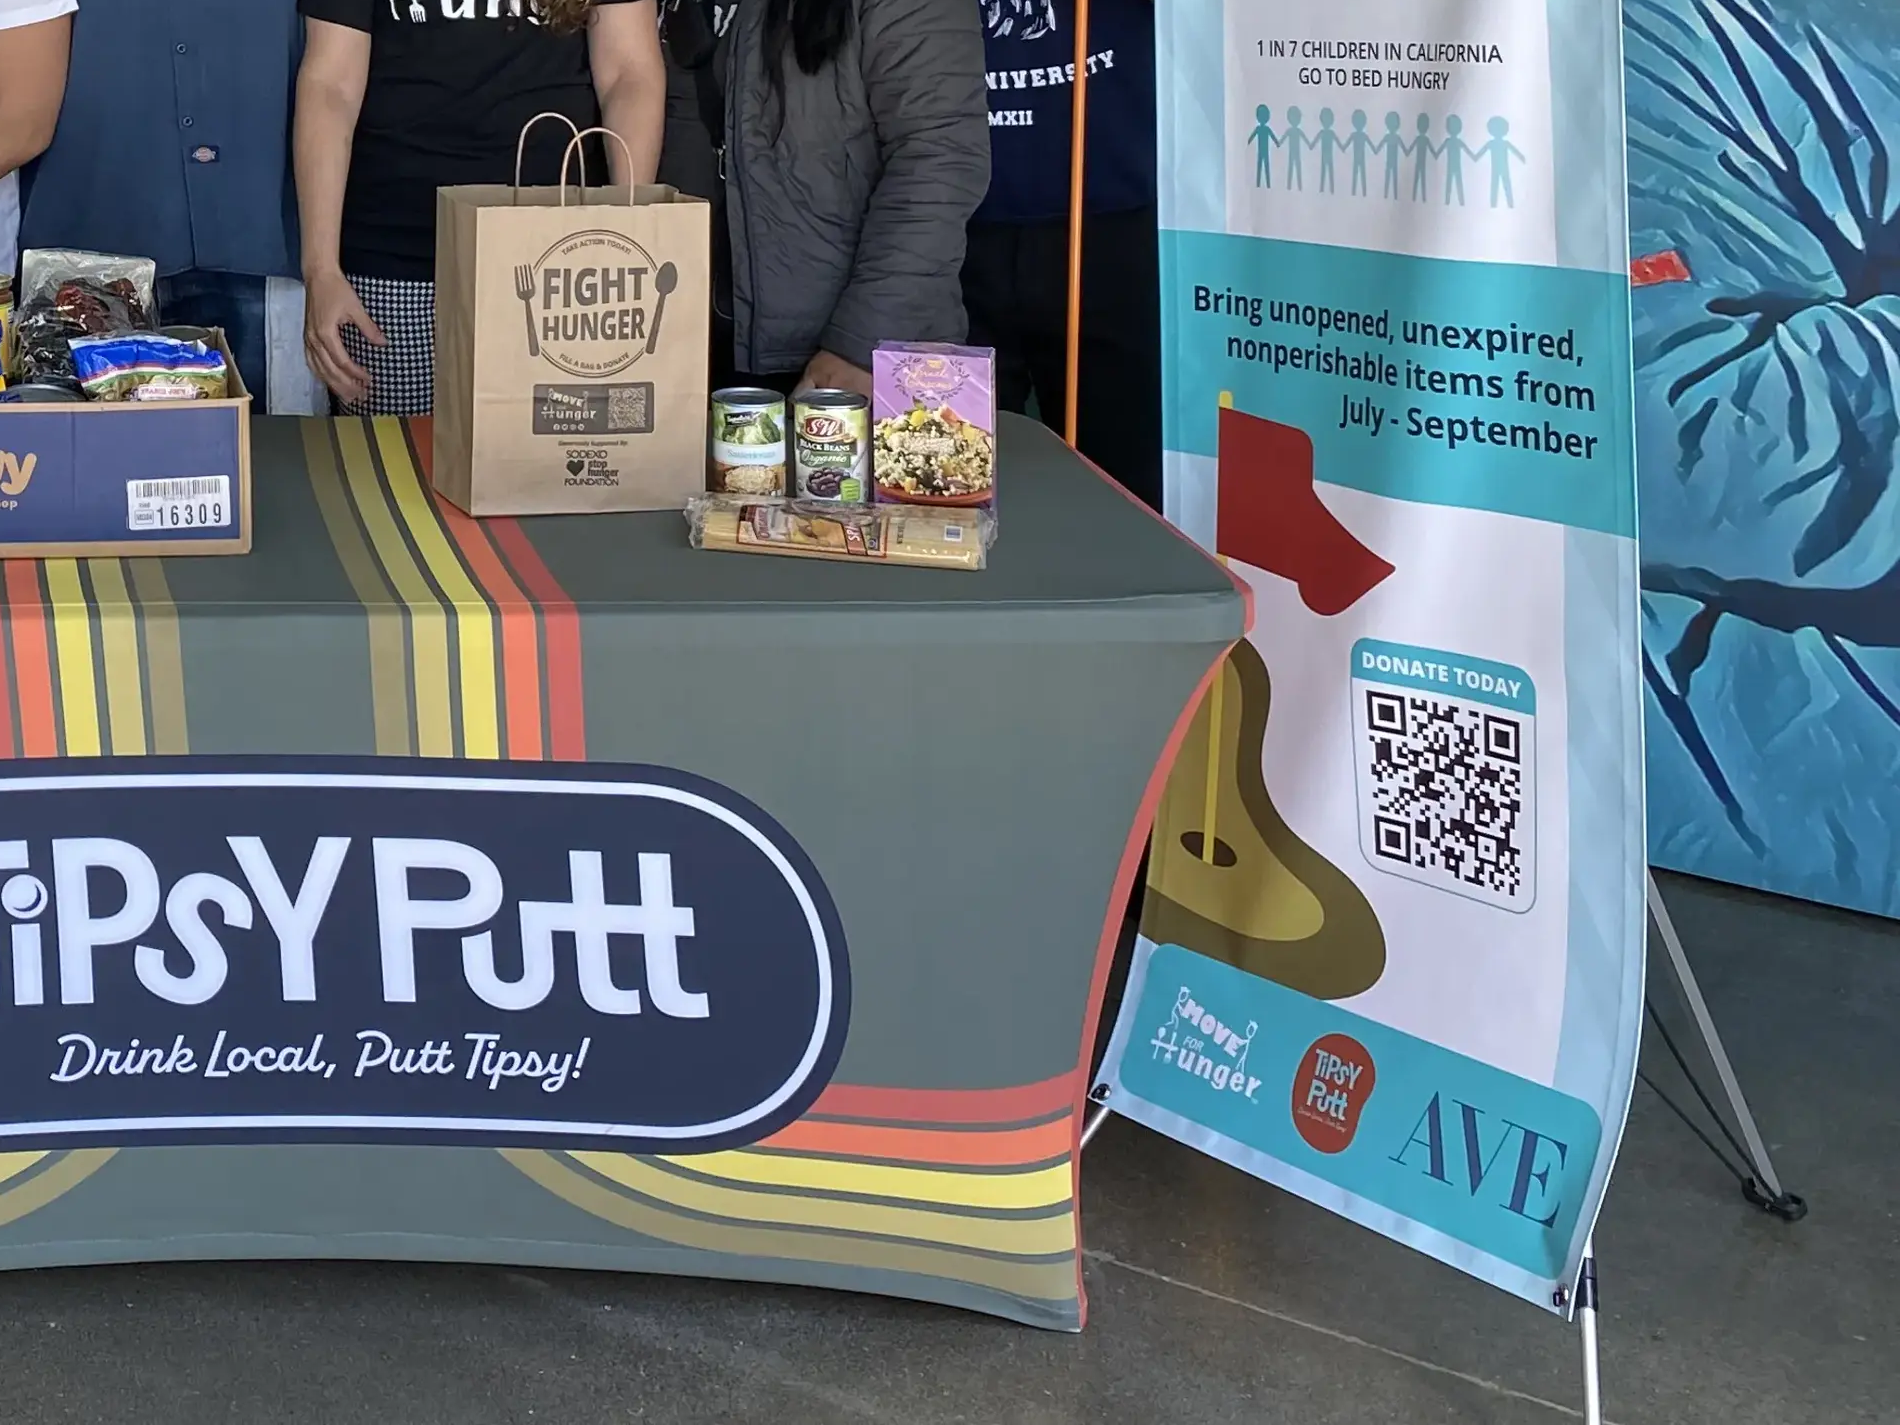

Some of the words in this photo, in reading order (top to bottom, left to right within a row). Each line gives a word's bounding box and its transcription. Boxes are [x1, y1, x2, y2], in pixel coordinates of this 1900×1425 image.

[1257, 40, 1264, 57] 1
[1269, 42, 1285, 57] IN
[1289, 41, 1297, 57] 7
[1301, 42, 1379, 60] CHILDREN
[1384, 44, 1401, 61] IN
[1407, 44, 1503, 64] CALIFORNIA
[1299, 68, 1320, 85] GO
[1327, 69, 1347, 86] TO
[1352, 70, 1383, 88] BED
[1388, 71, 1450, 90] HUNGRY
[562, 243, 578, 255] TAKE
[580, 239, 605, 248] ACTION
[607, 239, 631, 255] TODAY!
[543, 267, 649, 310] FIGHT
[543, 308, 645, 340] HUNGER
[1194, 285, 1263, 327] Bring
[1269, 299, 1395, 345] unopened,
[1402, 319, 1584, 367] unexpired,
[1227, 335, 1398, 385] nonperishable
[1405, 370, 1503, 399] items
[1514, 372, 1595, 412] from
[1340, 394, 1385, 437] July
[1407, 408, 1598, 460] September
[566, 450, 607, 459] SODEXO
[800, 440, 824, 450] BLACK
[824, 443, 850, 451] BEANS
[588, 460, 607, 468] stop
[801, 451, 847, 467] Organic
[564, 478, 619, 486] FOUNDATION
[588, 468, 619, 478] hunger
[156, 503, 222, 526] 16309
[1362, 651, 1448, 682] DONATE
[1452, 667, 1521, 699] TODAY
[49, 1032, 197, 1083] Drink
[204, 1029, 336, 1079] Local,
[355, 1033, 454, 1077] Putt
[463, 1033, 591, 1092] Tipsy!
[1389, 1091, 1568, 1229] AVE
